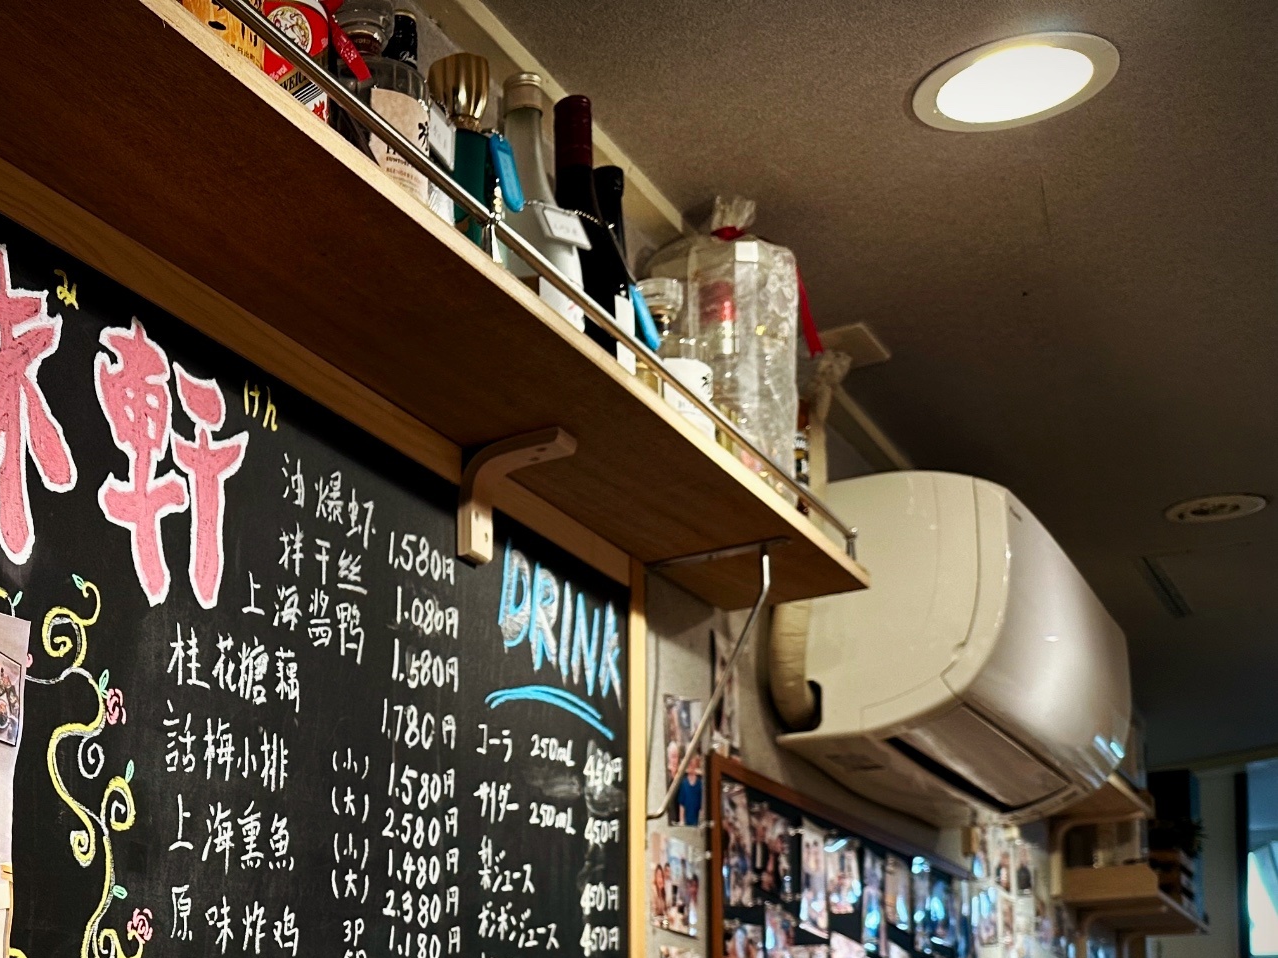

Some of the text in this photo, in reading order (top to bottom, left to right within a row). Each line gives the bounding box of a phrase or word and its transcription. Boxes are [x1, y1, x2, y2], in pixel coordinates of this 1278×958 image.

[54, 268, 80, 309] み
[243, 380, 279, 432] けん
[498, 537, 623, 710] DRINK
